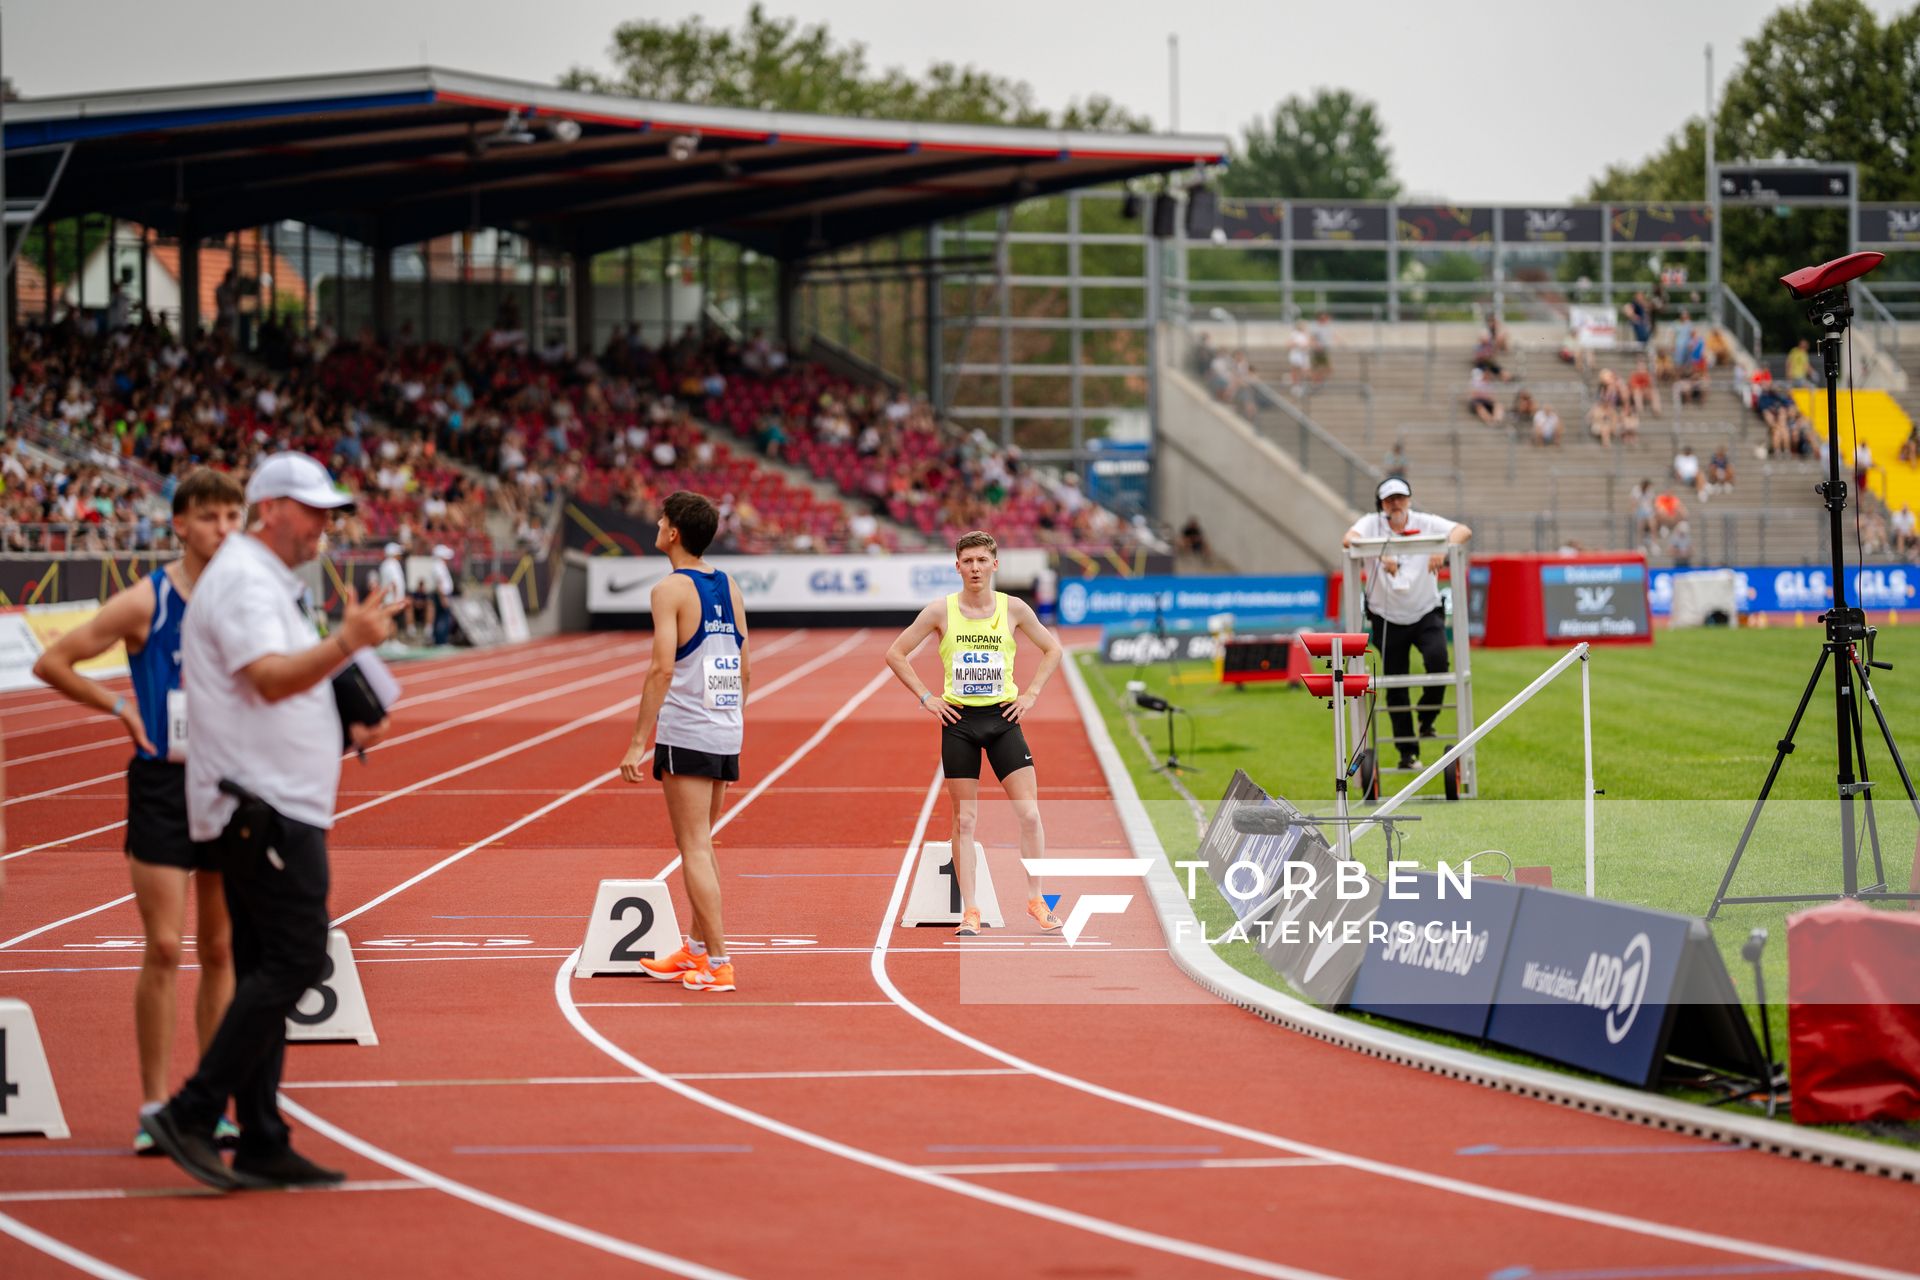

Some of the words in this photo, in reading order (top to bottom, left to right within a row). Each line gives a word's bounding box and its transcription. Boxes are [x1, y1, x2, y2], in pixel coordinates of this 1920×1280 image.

[956, 635, 1002, 643] PINGPANK
[973, 643, 999, 651] running
[955, 668, 1002, 681] M.PINGPANK
[938, 857, 963, 913] 1
[609, 896, 655, 962] 2
[1575, 952, 1622, 1010] ARD
